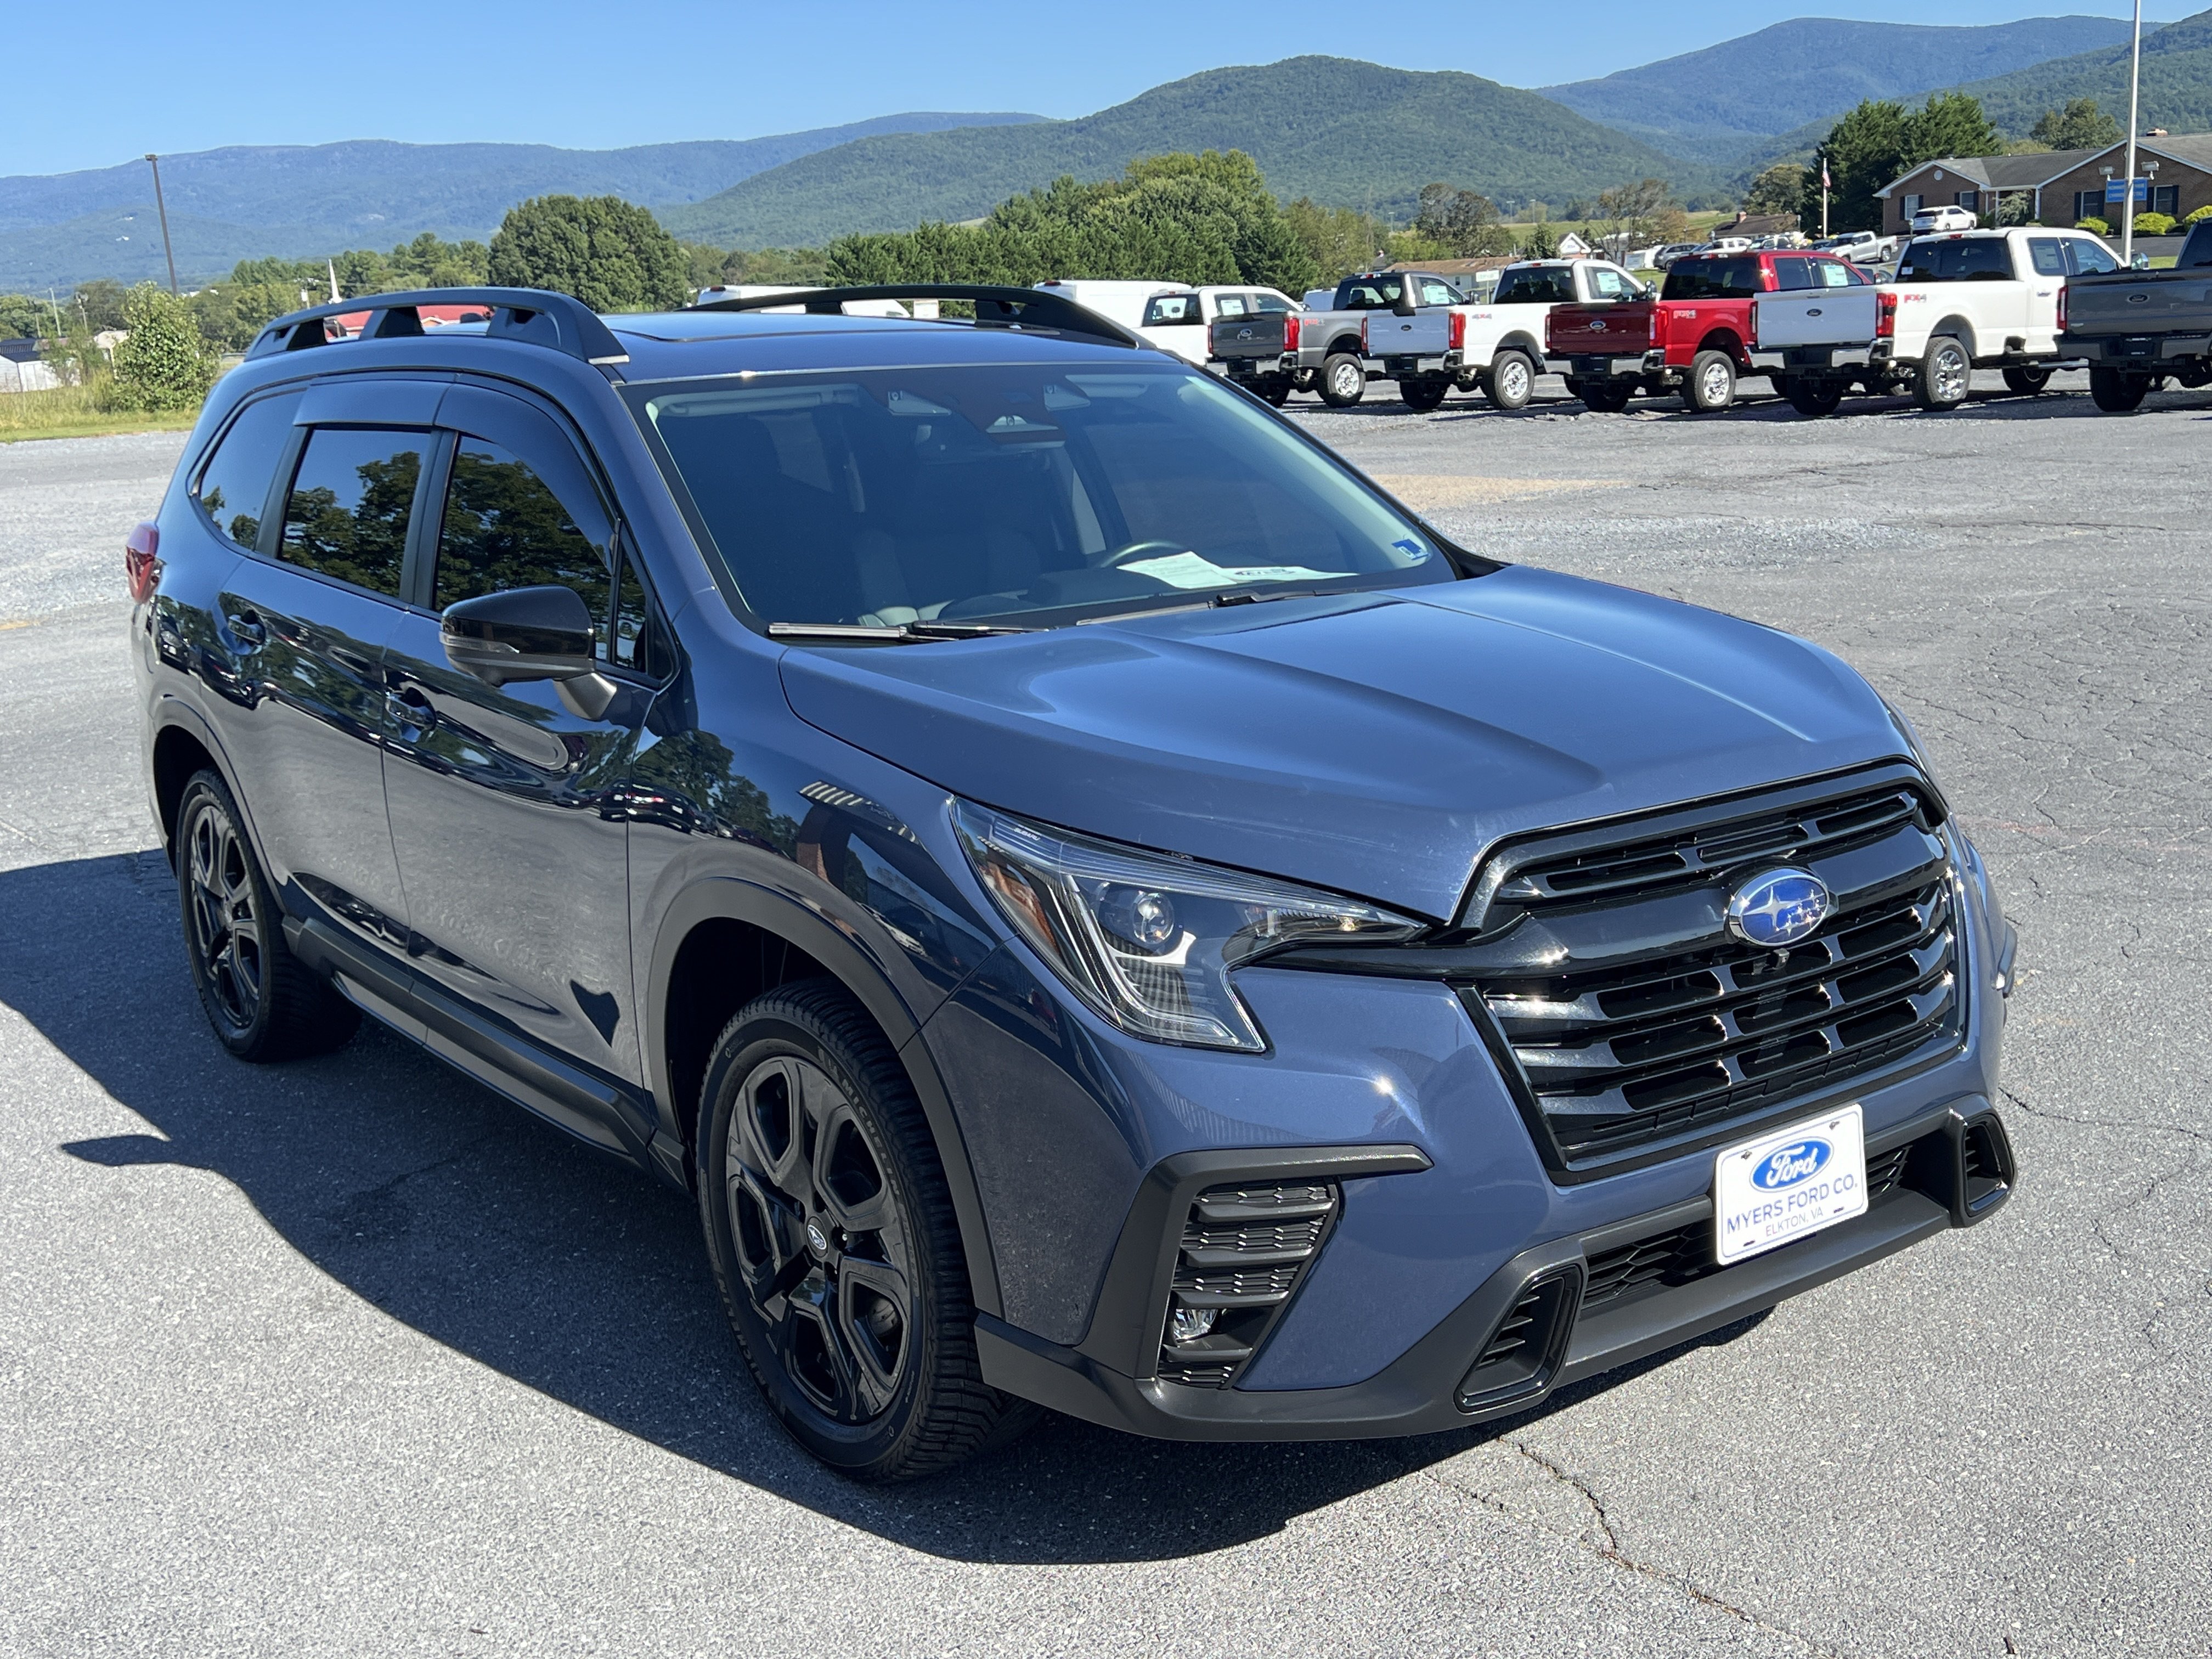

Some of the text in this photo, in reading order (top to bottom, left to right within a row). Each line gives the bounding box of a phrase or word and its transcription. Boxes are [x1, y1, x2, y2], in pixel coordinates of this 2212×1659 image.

[1904, 294, 1927, 303] FX4
[841, 1079, 900, 1197] MICHELIN
[1766, 1145, 1818, 1187] Ford
[1727, 1174, 1858, 1234] MYERS FORD CO.
[1810, 1206, 1823, 1220] VA
[718, 1278, 767, 1386] MICHELIN
